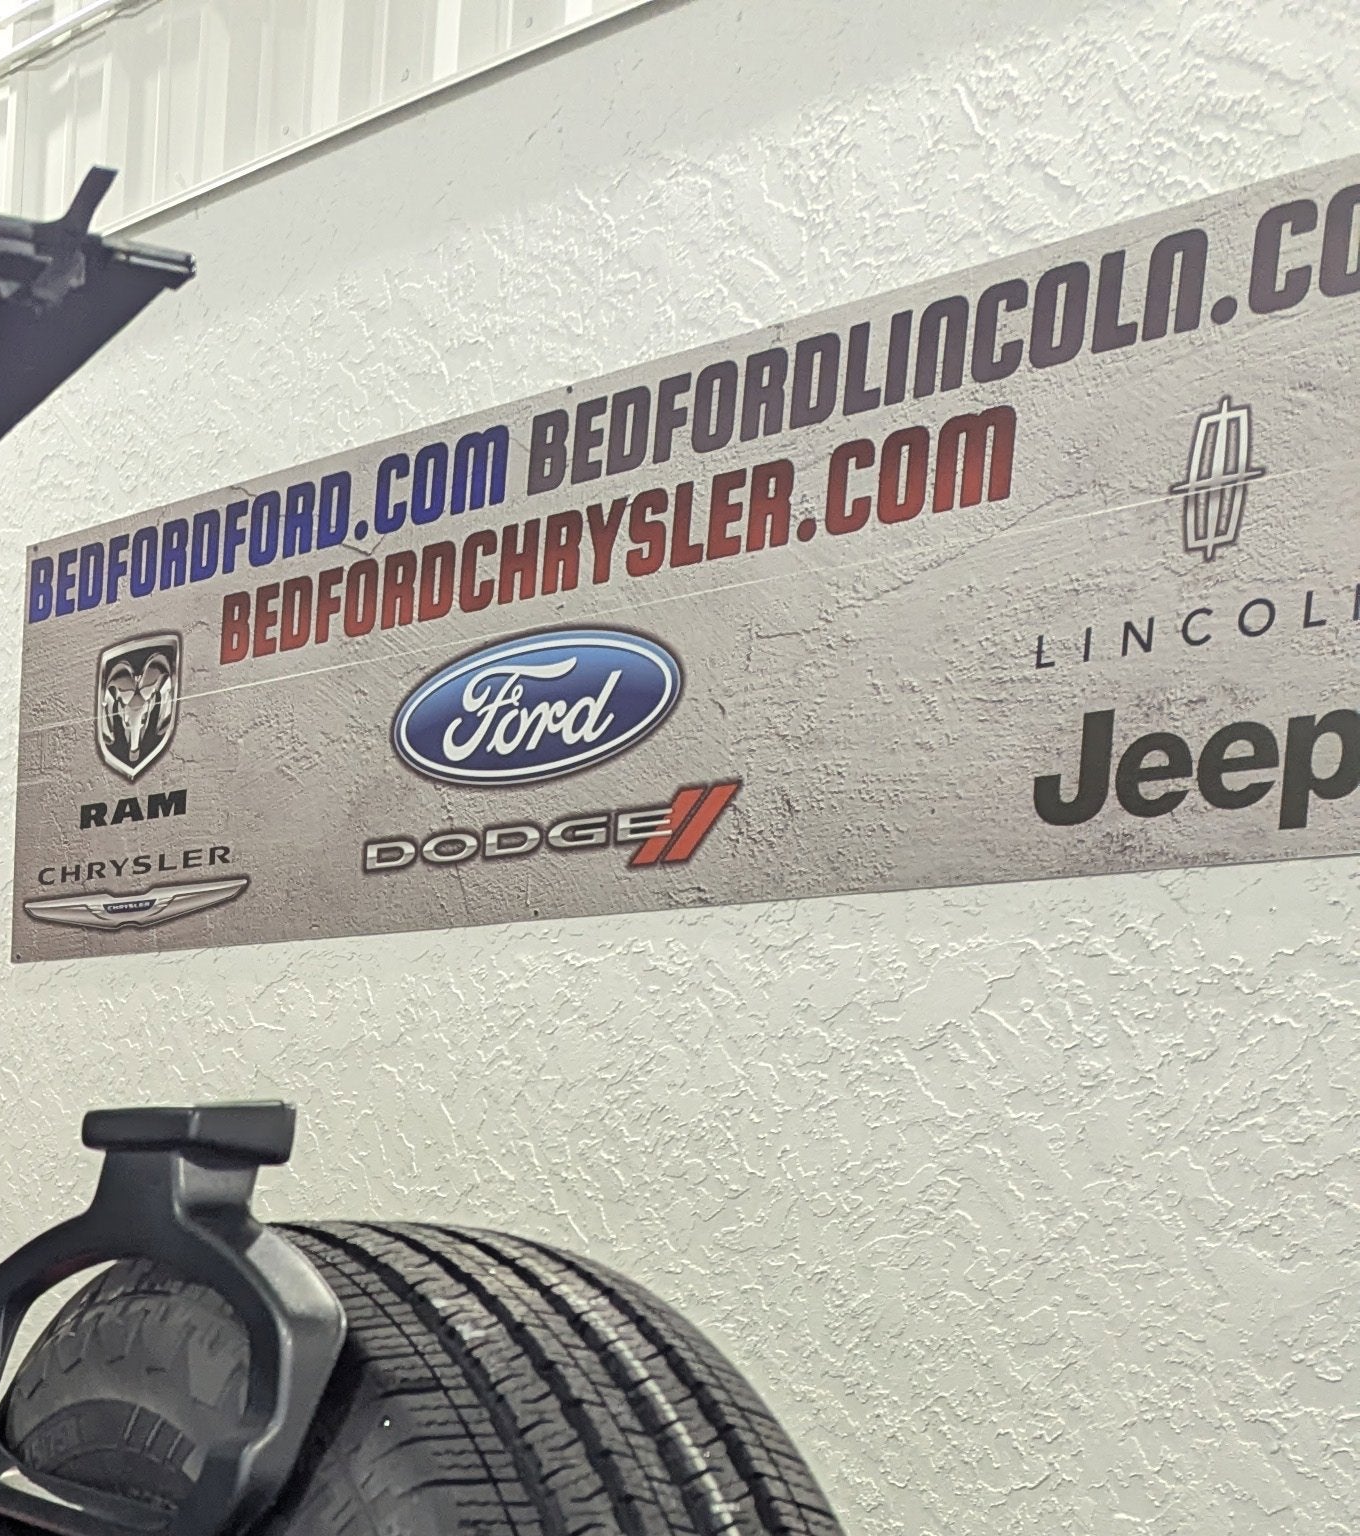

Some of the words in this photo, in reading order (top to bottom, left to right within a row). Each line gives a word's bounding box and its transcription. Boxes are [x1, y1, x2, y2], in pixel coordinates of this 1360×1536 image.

[28, 424, 510, 625] BEDFORDFORD.COM
[219, 404, 1018, 666] BEDFORDCHRYSLER.COM
[1035, 583, 1360, 670] LINCOL
[443, 656, 622, 762] Ford
[80, 789, 188, 830] RAM
[1032, 708, 1360, 830] Jeep
[37, 846, 231, 886] CHRYSLER
[364, 807, 674, 871] DODGE
